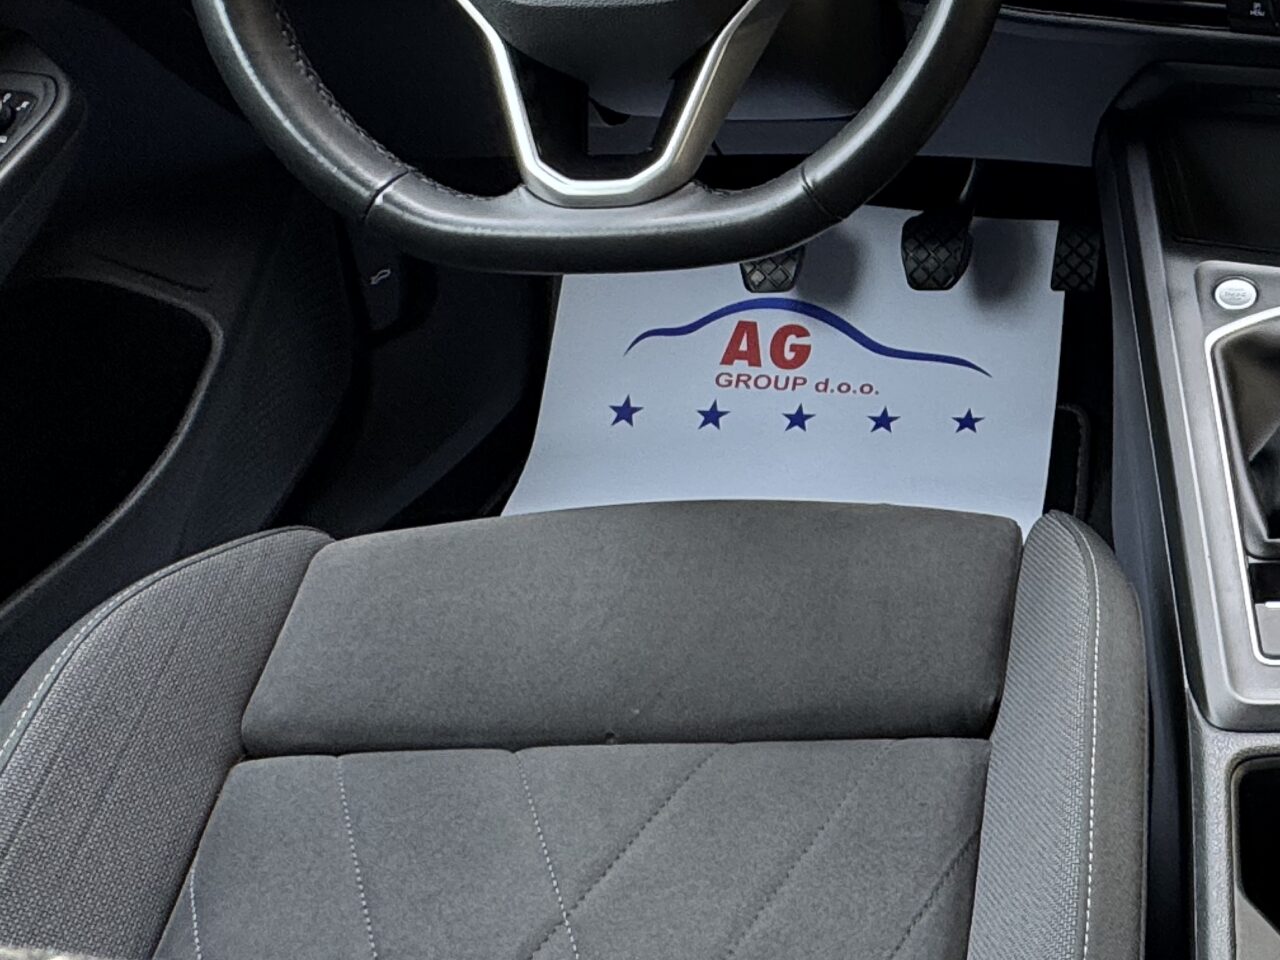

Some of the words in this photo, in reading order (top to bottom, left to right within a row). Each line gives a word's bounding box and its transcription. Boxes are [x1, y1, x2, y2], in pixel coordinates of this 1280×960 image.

[719, 320, 812, 371] AG
[714, 372, 808, 392] GROUP
[814, 377, 880, 395] d.o.o.
